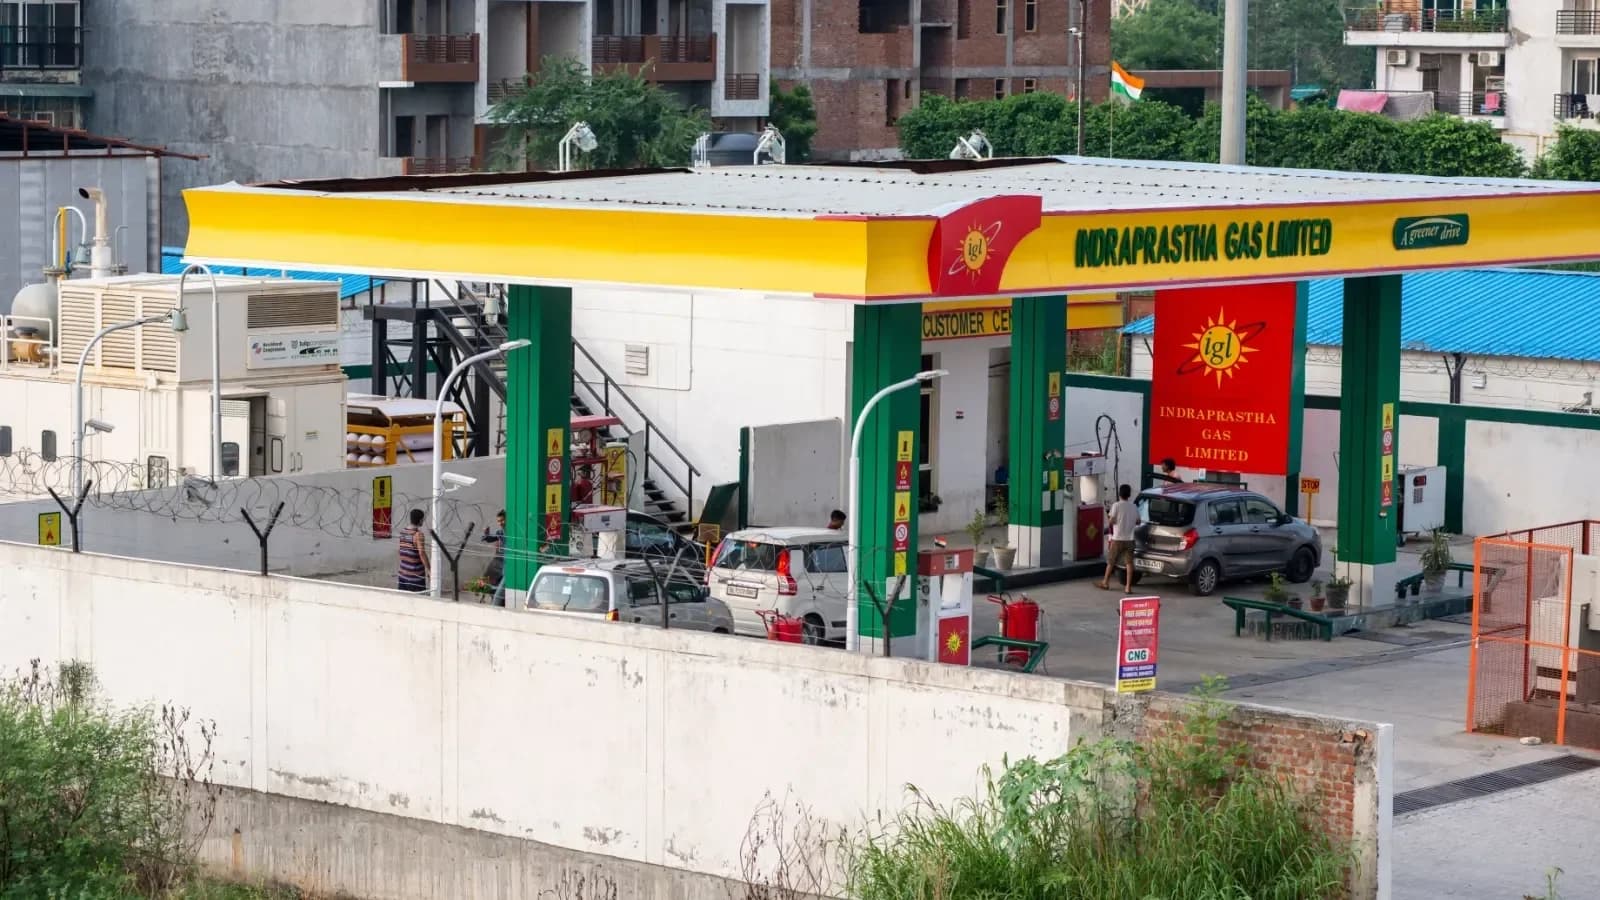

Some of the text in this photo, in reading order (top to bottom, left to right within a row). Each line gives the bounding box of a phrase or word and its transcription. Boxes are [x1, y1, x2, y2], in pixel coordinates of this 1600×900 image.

[1075, 218, 1332, 268] INDRAPRASTHA GAS LIMITED
[1400, 224, 1461, 246] A greener drive
[968, 237, 983, 262] igl
[922, 311, 985, 338] CUSTOMER
[1203, 331, 1233, 366] igl
[1160, 406, 1277, 425] INDRAPRASTHA
[1201, 428, 1232, 441] GAS
[1185, 446, 1249, 462] LIMITED
[1302, 479, 1320, 489] STOP
[1127, 649, 1147, 661] CNG
